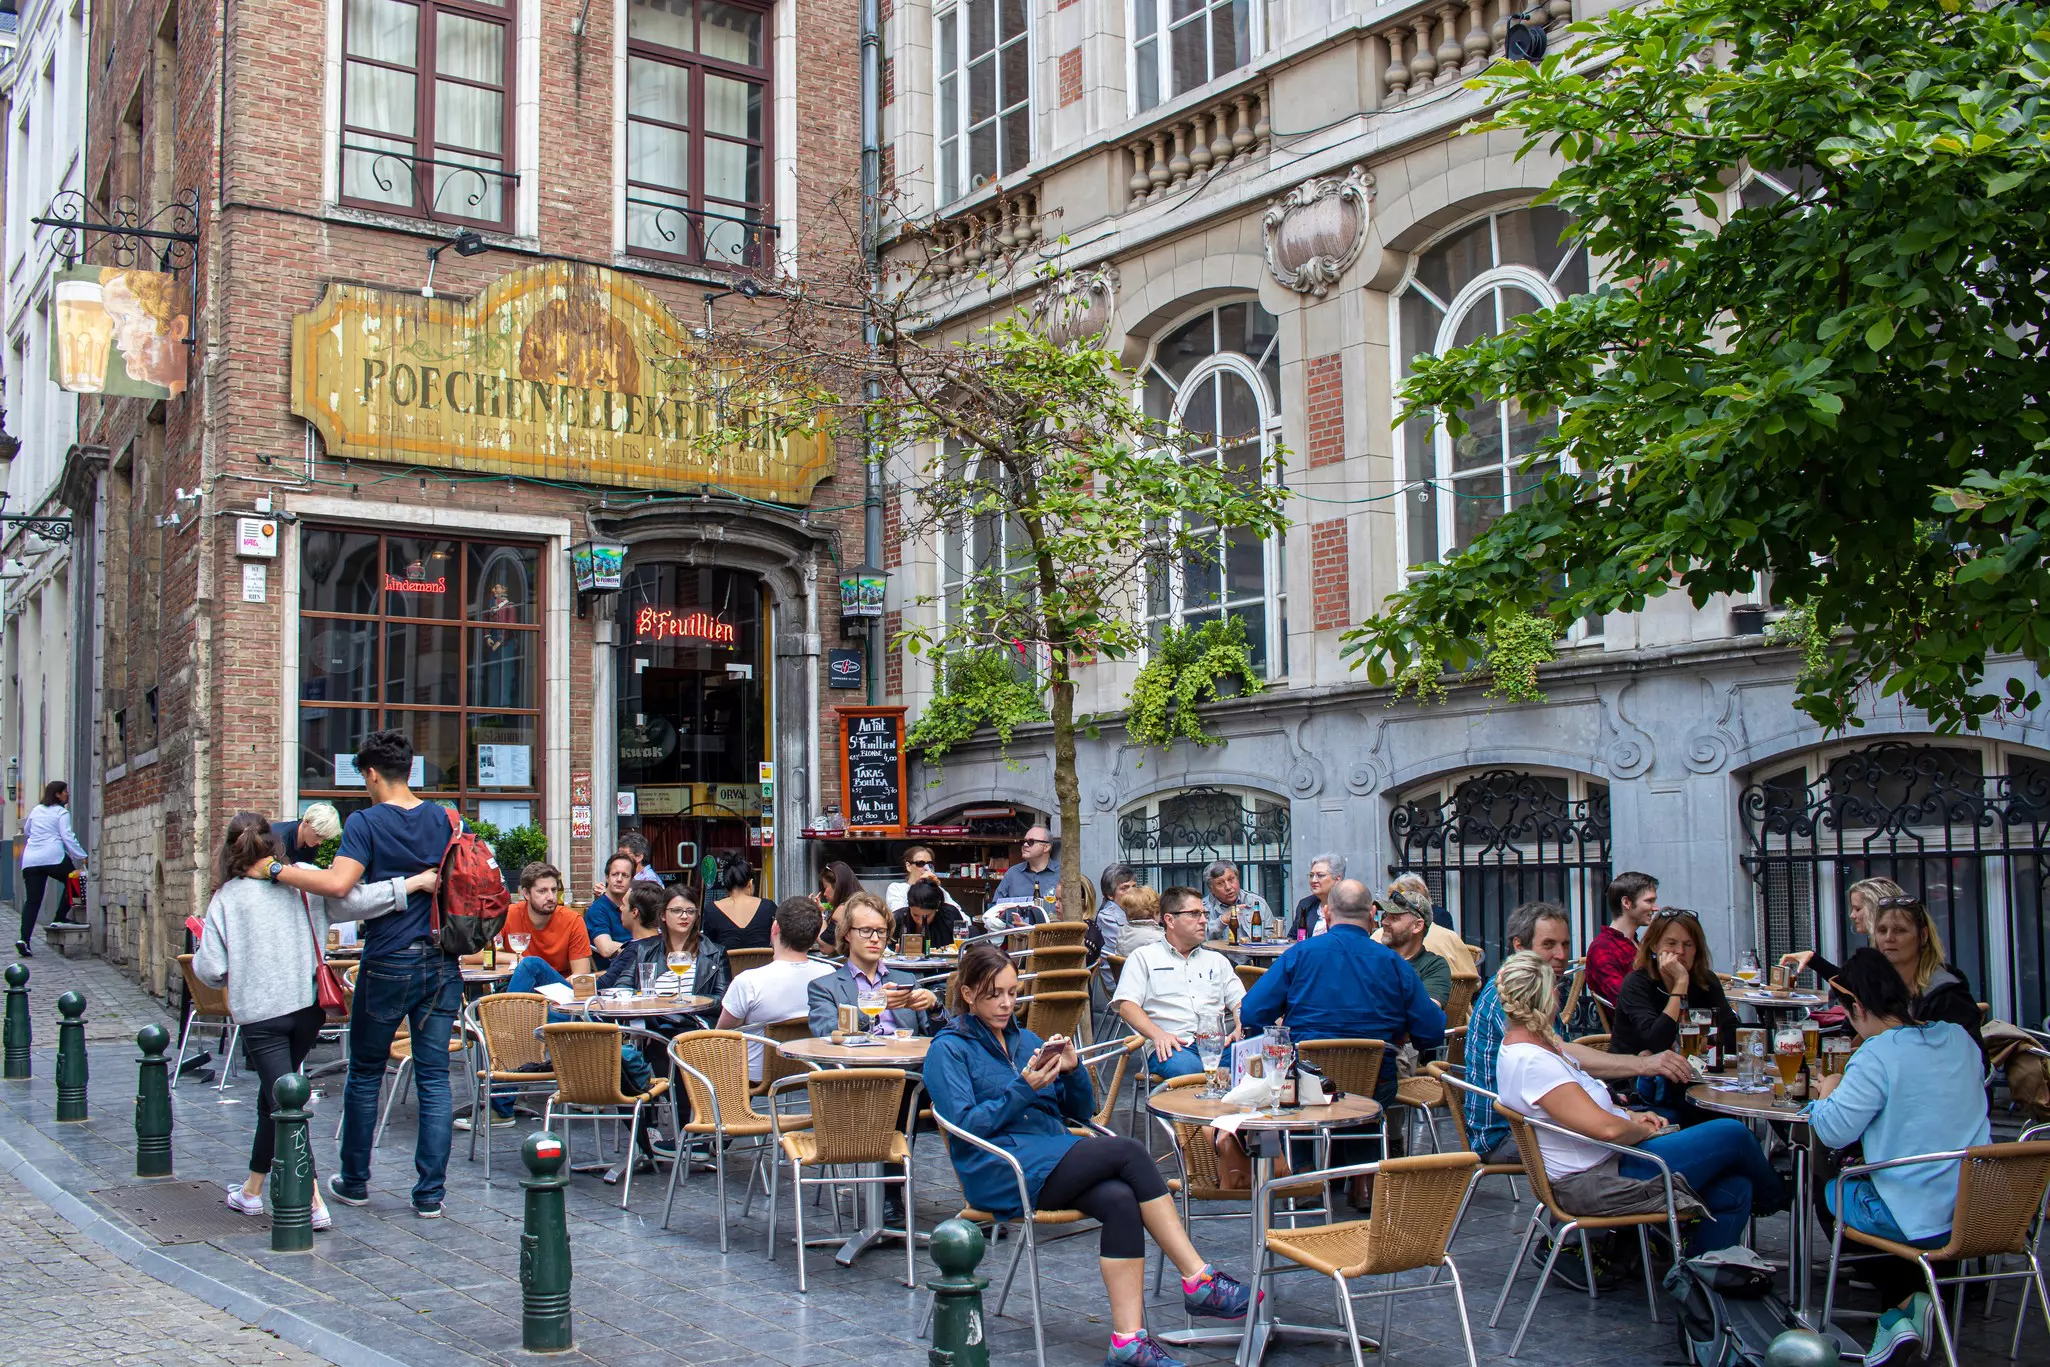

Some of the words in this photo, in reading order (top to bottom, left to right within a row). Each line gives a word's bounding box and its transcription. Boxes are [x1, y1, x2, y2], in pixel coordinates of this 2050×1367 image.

[524, 431, 539, 448] OF
[622, 441, 641, 459] PIS
[657, 609, 734, 642] Feuillien
[720, 788, 750, 800] ORVAL
